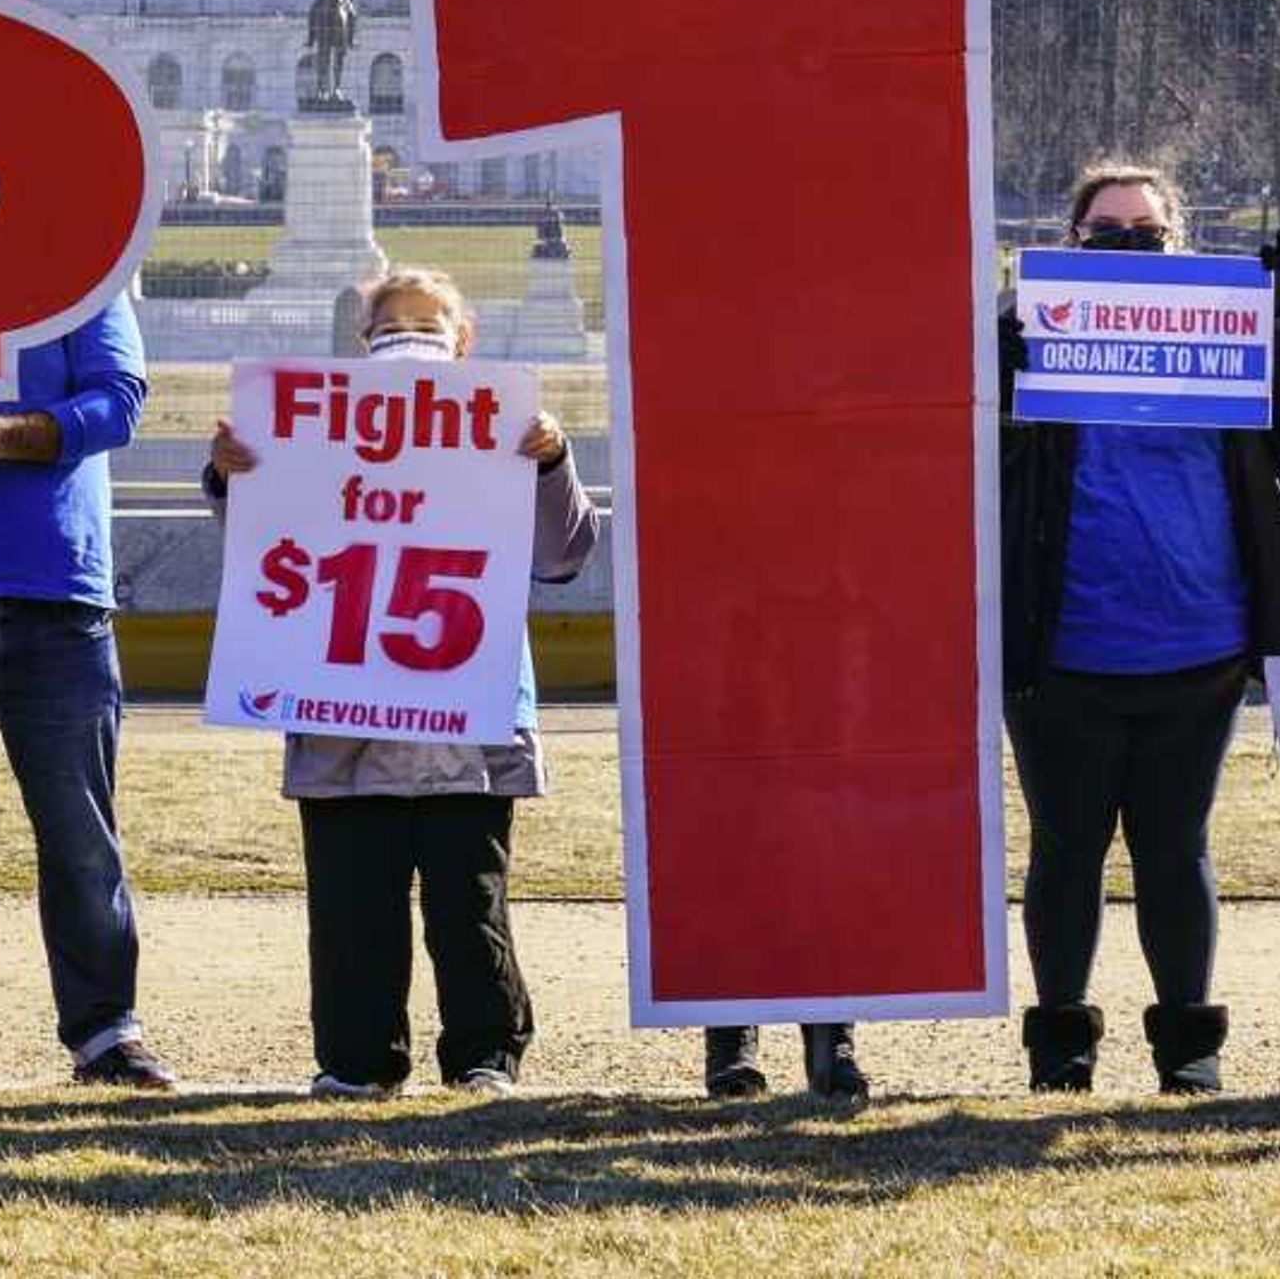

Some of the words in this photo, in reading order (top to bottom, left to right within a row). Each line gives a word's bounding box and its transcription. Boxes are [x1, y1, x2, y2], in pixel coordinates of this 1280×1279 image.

[1095, 303, 1259, 336] REVOLUTION
[1042, 341, 1157, 373] ORGANIZE
[1162, 346, 1191, 374] TO
[1198, 348, 1245, 377] WIN
[271, 371, 502, 464] Fight
[341, 474, 426, 524] for
[256, 537, 489, 672] $15
[294, 697, 468, 734] REVOLUTION
